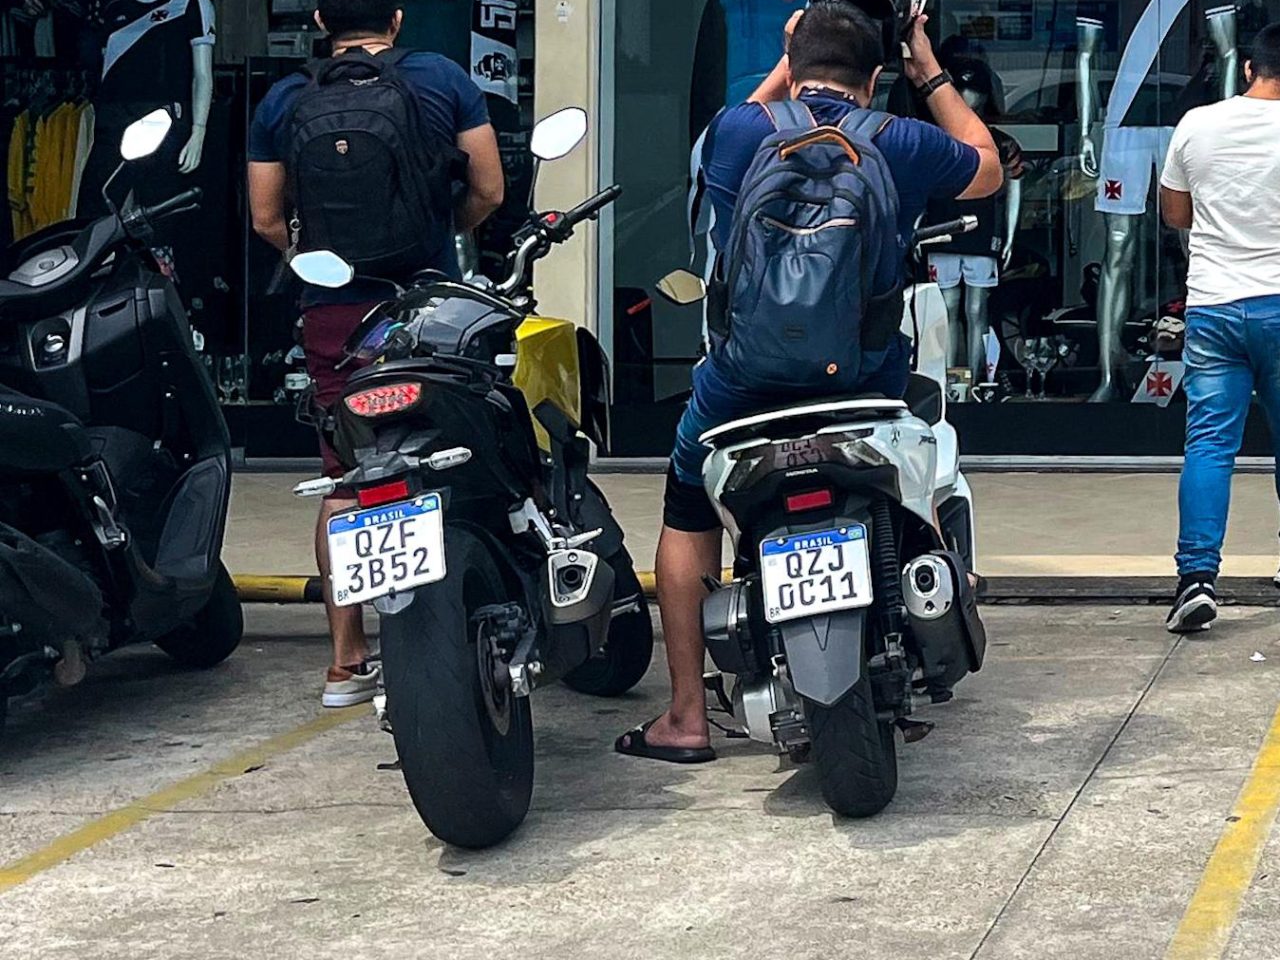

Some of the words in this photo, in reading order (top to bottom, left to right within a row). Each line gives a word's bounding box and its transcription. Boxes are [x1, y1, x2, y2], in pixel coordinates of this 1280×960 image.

[363, 509, 406, 527] BRASIL
[355, 518, 416, 558] QZF
[794, 536, 834, 551] BRASIL
[346, 547, 430, 594] 3B52
[786, 544, 845, 579] QZJ
[337, 589, 349, 602] BR
[769, 607, 781, 618] BR
